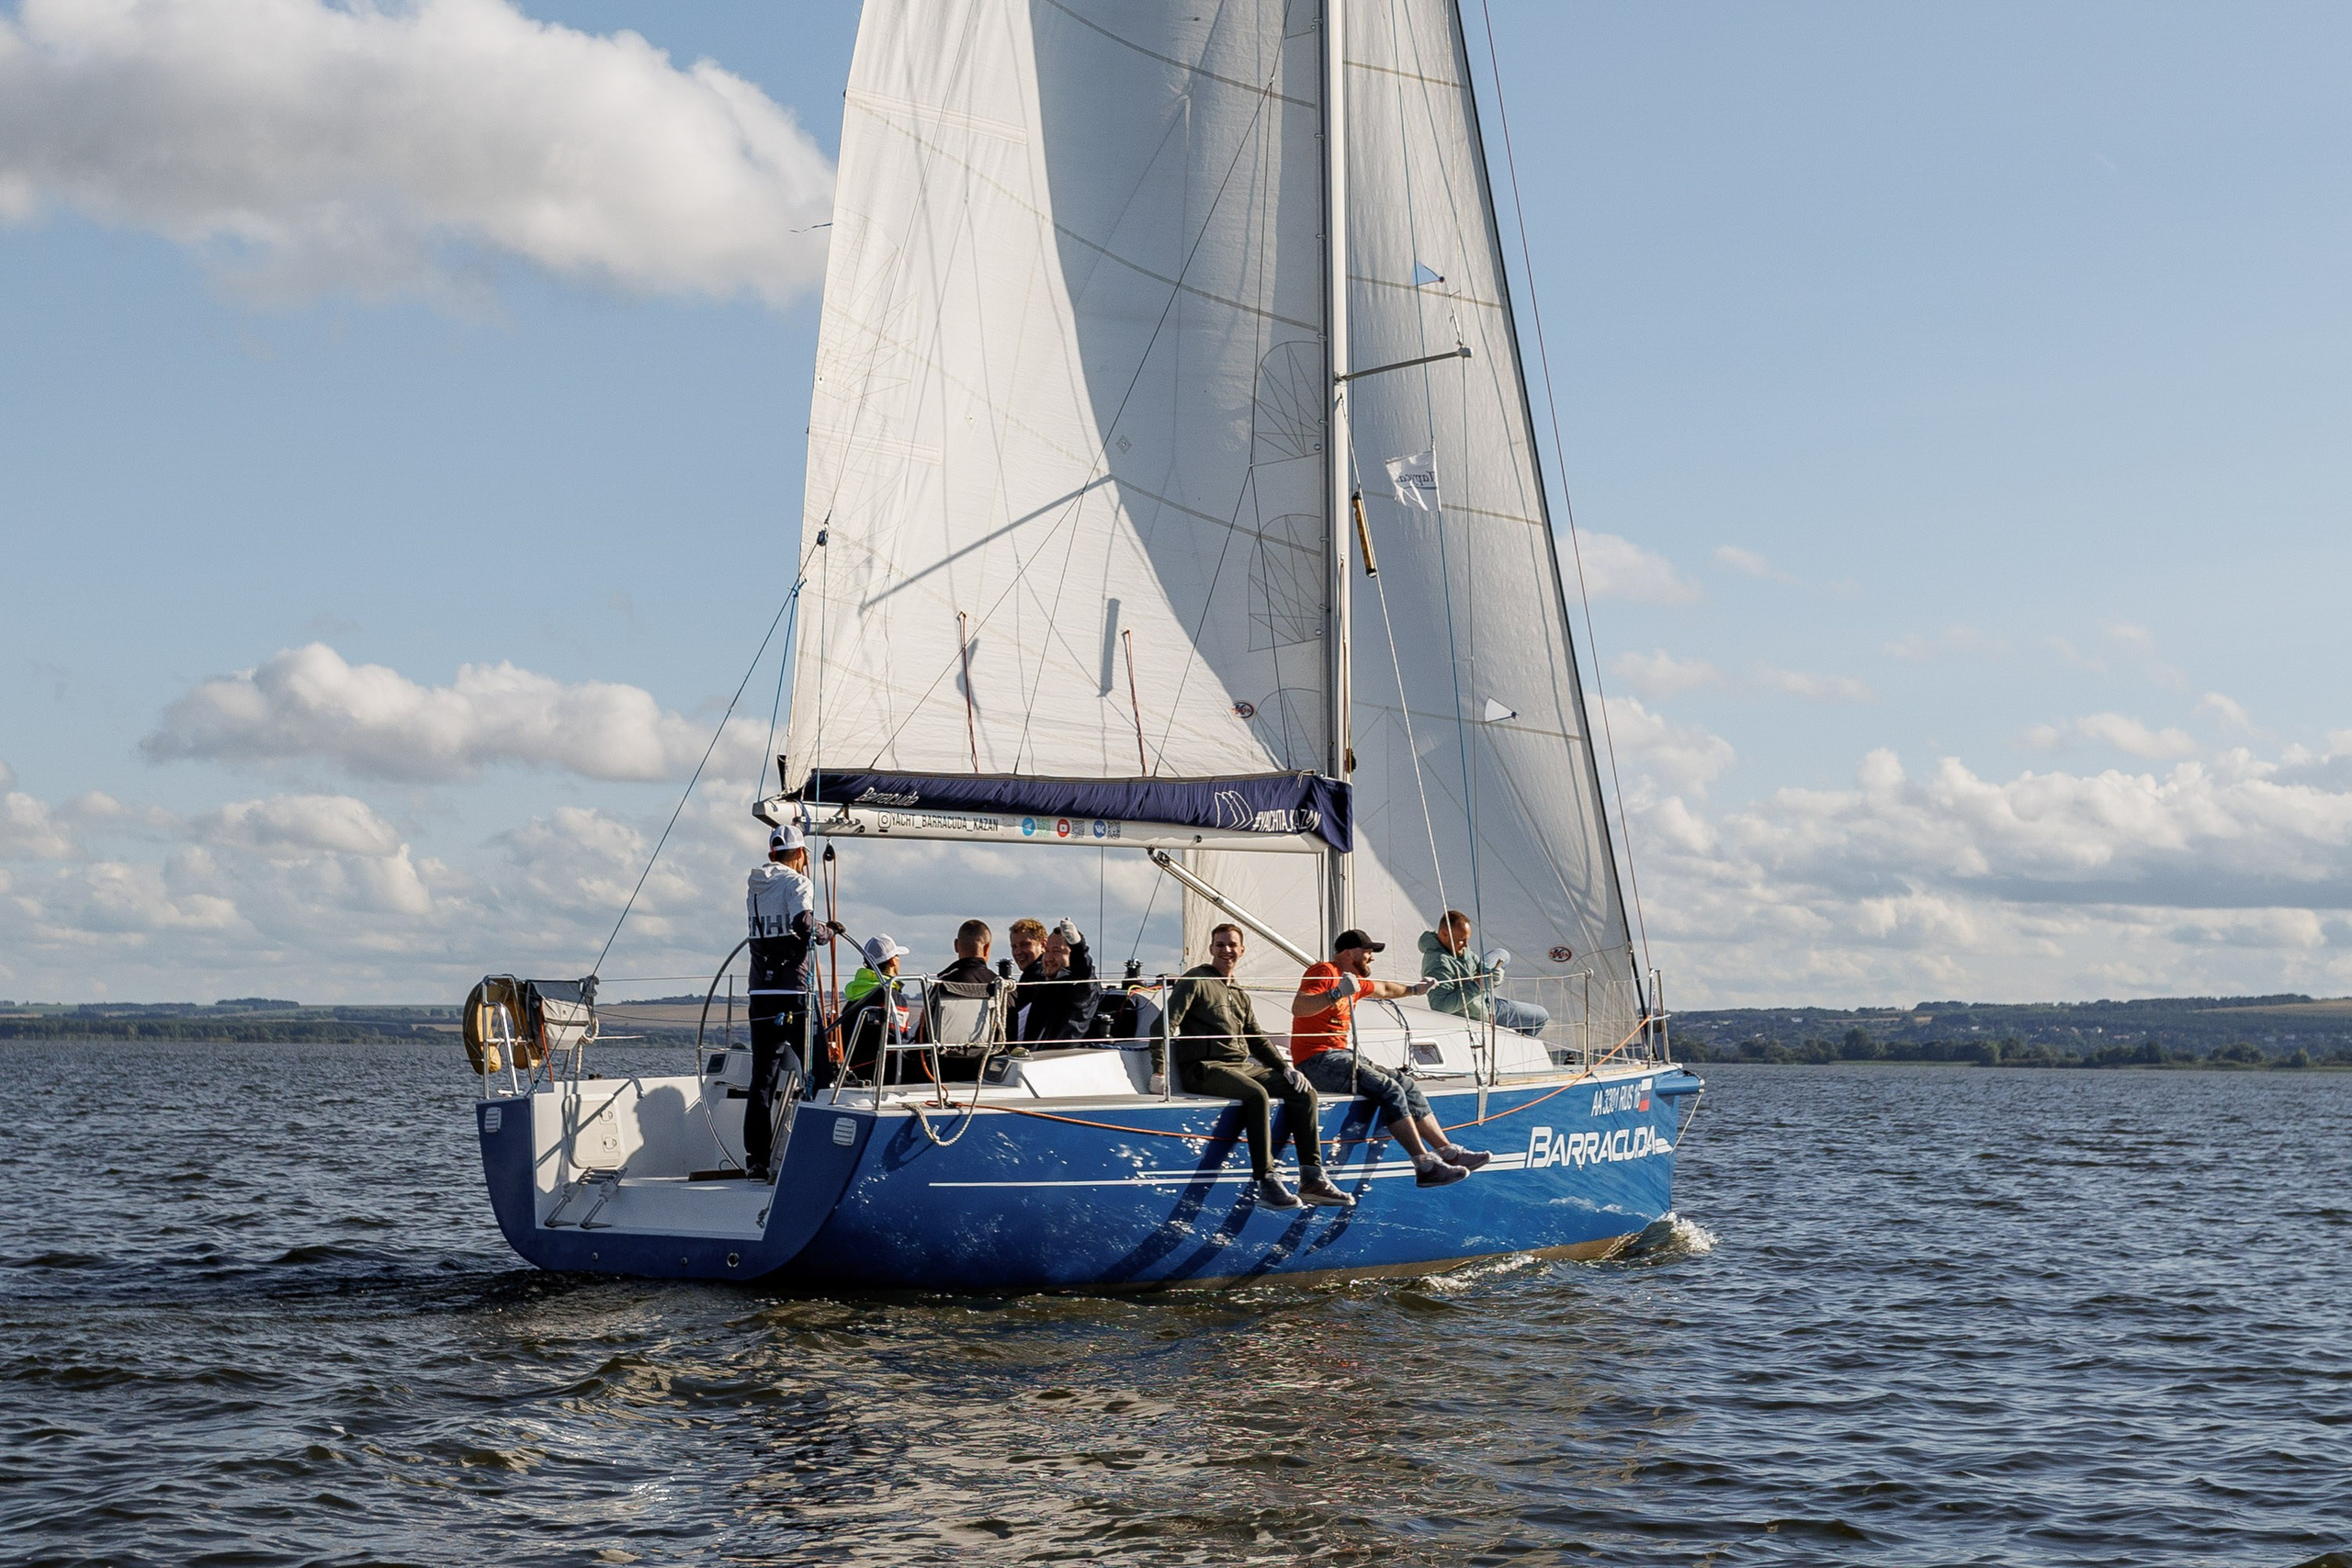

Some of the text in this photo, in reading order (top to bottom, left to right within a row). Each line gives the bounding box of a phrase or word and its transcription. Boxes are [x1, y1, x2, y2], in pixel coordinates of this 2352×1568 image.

[854, 786, 920, 807] Barracuda
[891, 812, 999, 832] YACHT_BARRACUDA_KAZAN
[1619, 1084, 1634, 1111] RUS
[1526, 1125, 1657, 1168] BARRACUDA
